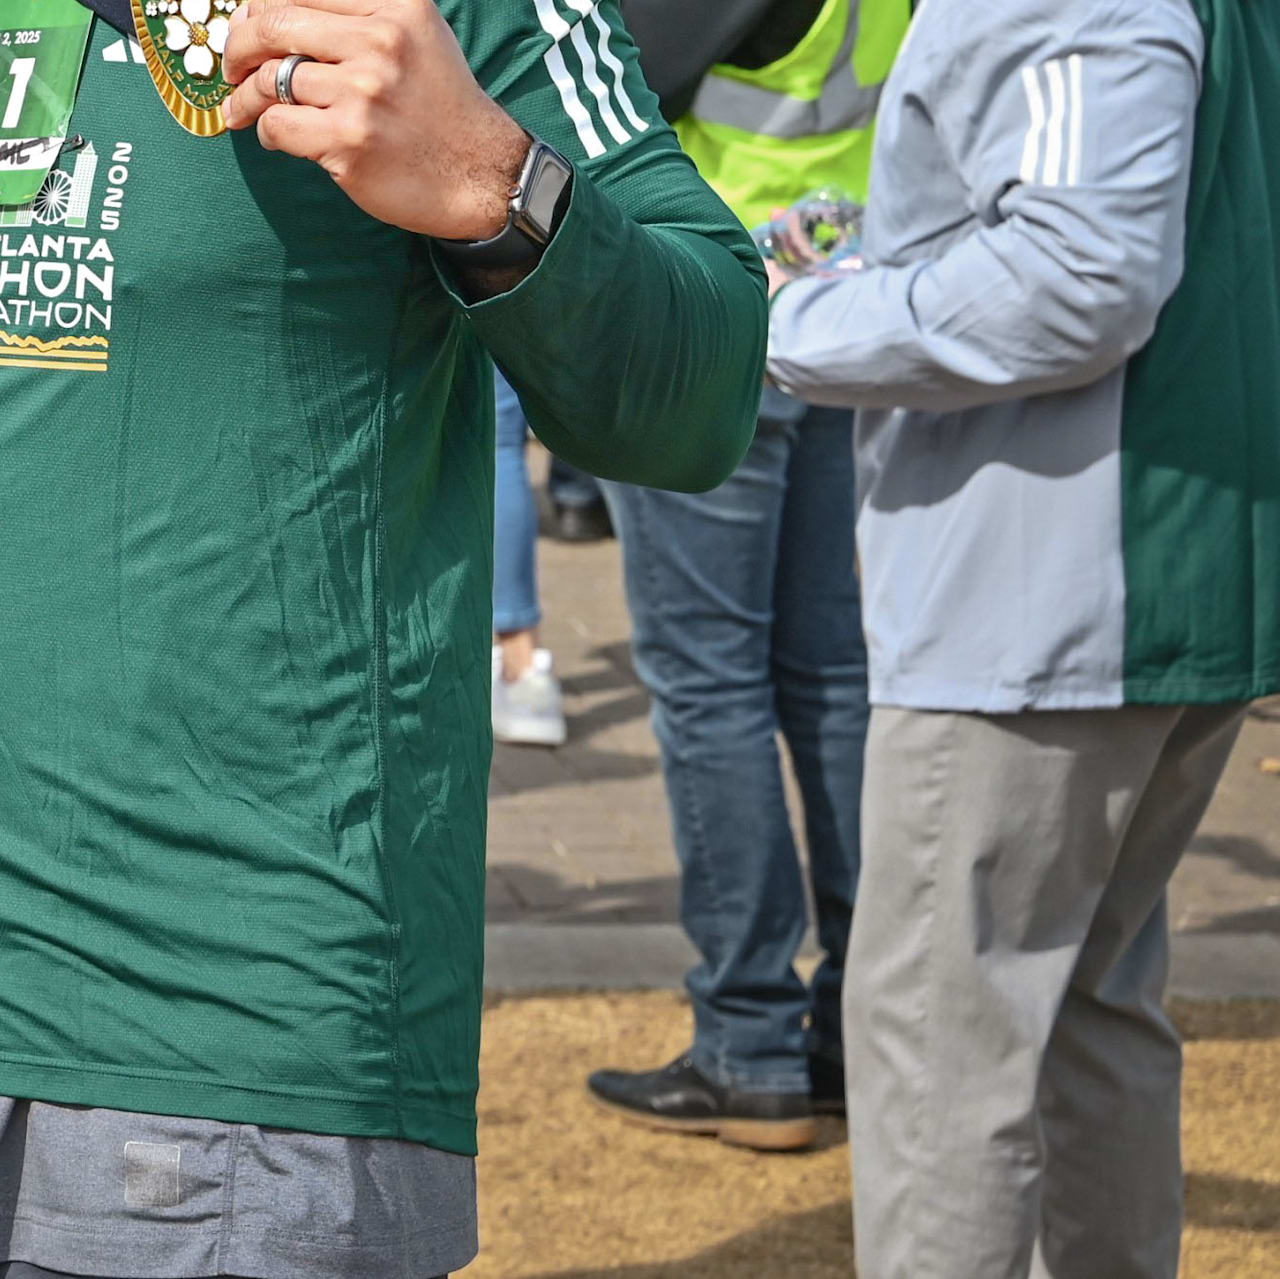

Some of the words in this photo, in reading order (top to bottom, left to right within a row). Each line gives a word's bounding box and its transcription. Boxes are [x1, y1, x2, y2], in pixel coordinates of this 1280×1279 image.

[2, 32, 11, 47] 2,
[14, 31, 41, 44] 2025
[154, 31, 185, 82] HALF
[183, 82, 229, 108] MARA
[100, 142, 133, 231] 2025
